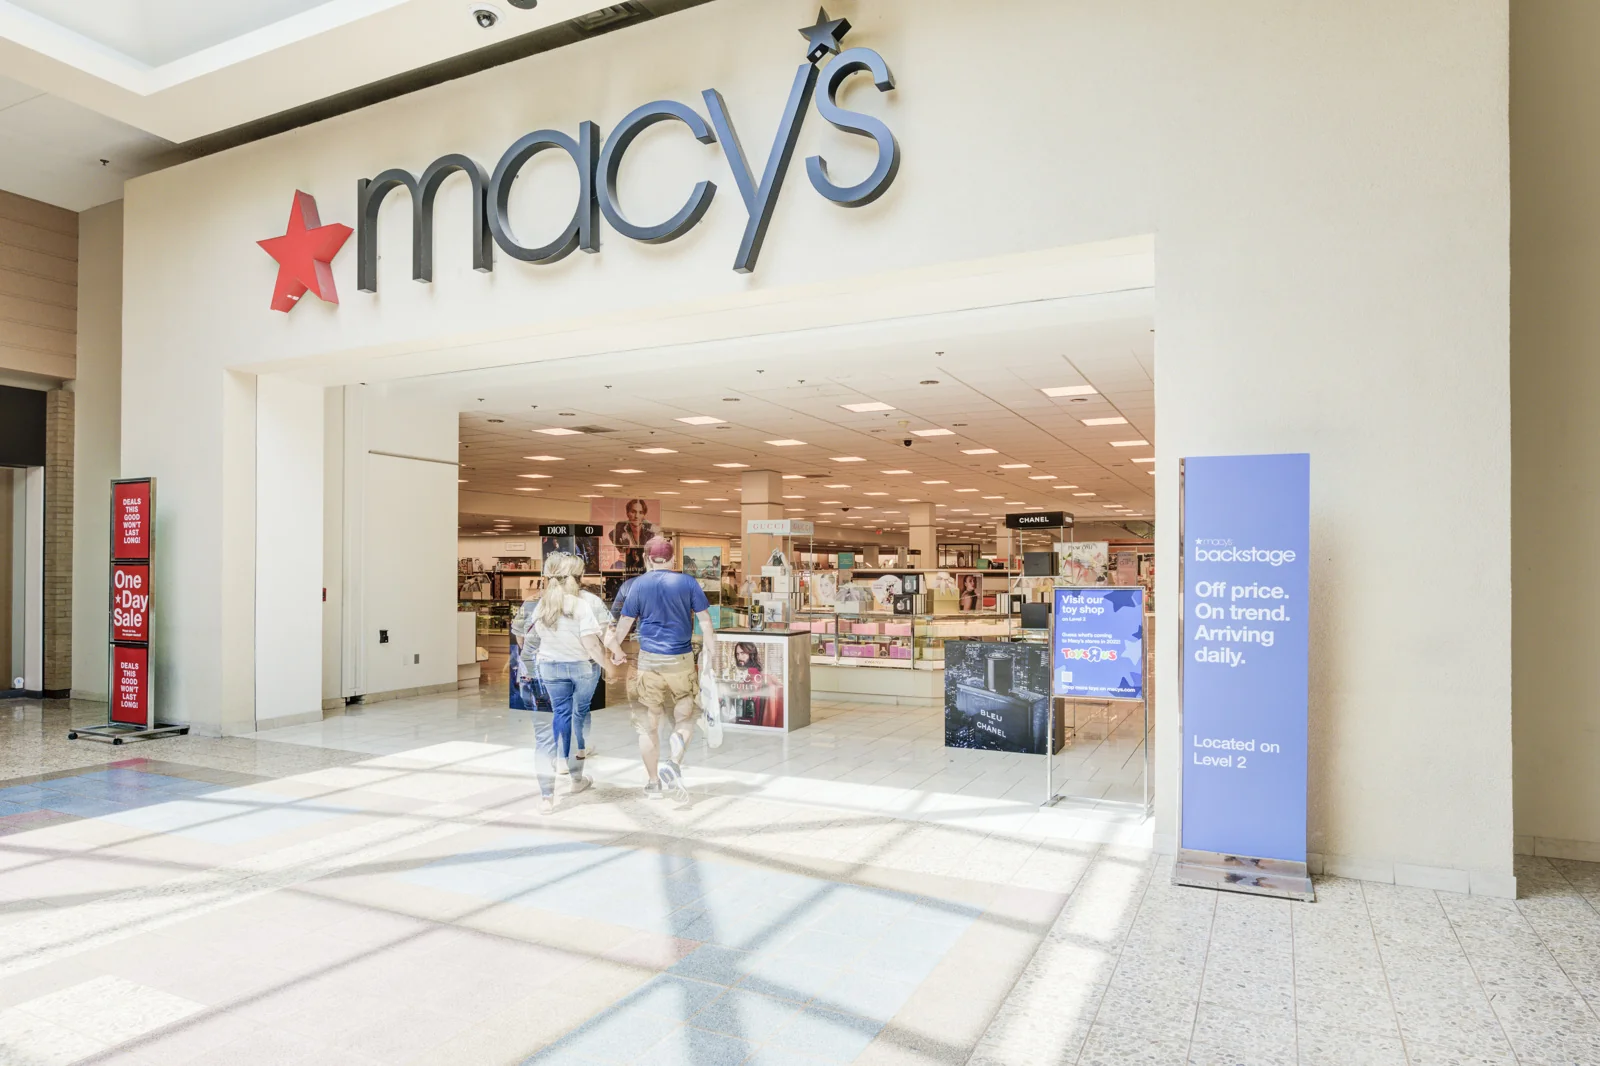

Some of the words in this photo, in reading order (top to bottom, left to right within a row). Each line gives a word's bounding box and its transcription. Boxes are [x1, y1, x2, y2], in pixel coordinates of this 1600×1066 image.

[1019, 516, 1049, 524] CHANEL
[547, 526, 567, 535] DIOR
[1195, 546, 1296, 566] backstage
[114, 569, 142, 589] One
[1062, 595, 1084, 604] Visit
[1195, 581, 1227, 598] Off
[1231, 582, 1290, 602] price.
[122, 590, 148, 613] Day
[1062, 606, 1078, 615] toy
[1079, 605, 1105, 616] shop
[114, 608, 142, 627] Sale
[1195, 602, 1225, 620] On
[1229, 604, 1291, 622] trend.
[1194, 624, 1274, 647] Arriving
[1194, 646, 1246, 668] daily.
[121, 685, 138, 693] WON'T
[980, 709, 1003, 722] BLEU
[976, 721, 1007, 738] CHANEL
[1193, 734, 1255, 752] Located
[1260, 742, 1280, 753] on
[1193, 752, 1232, 768] Level
[1237, 756, 1247, 769] 2
